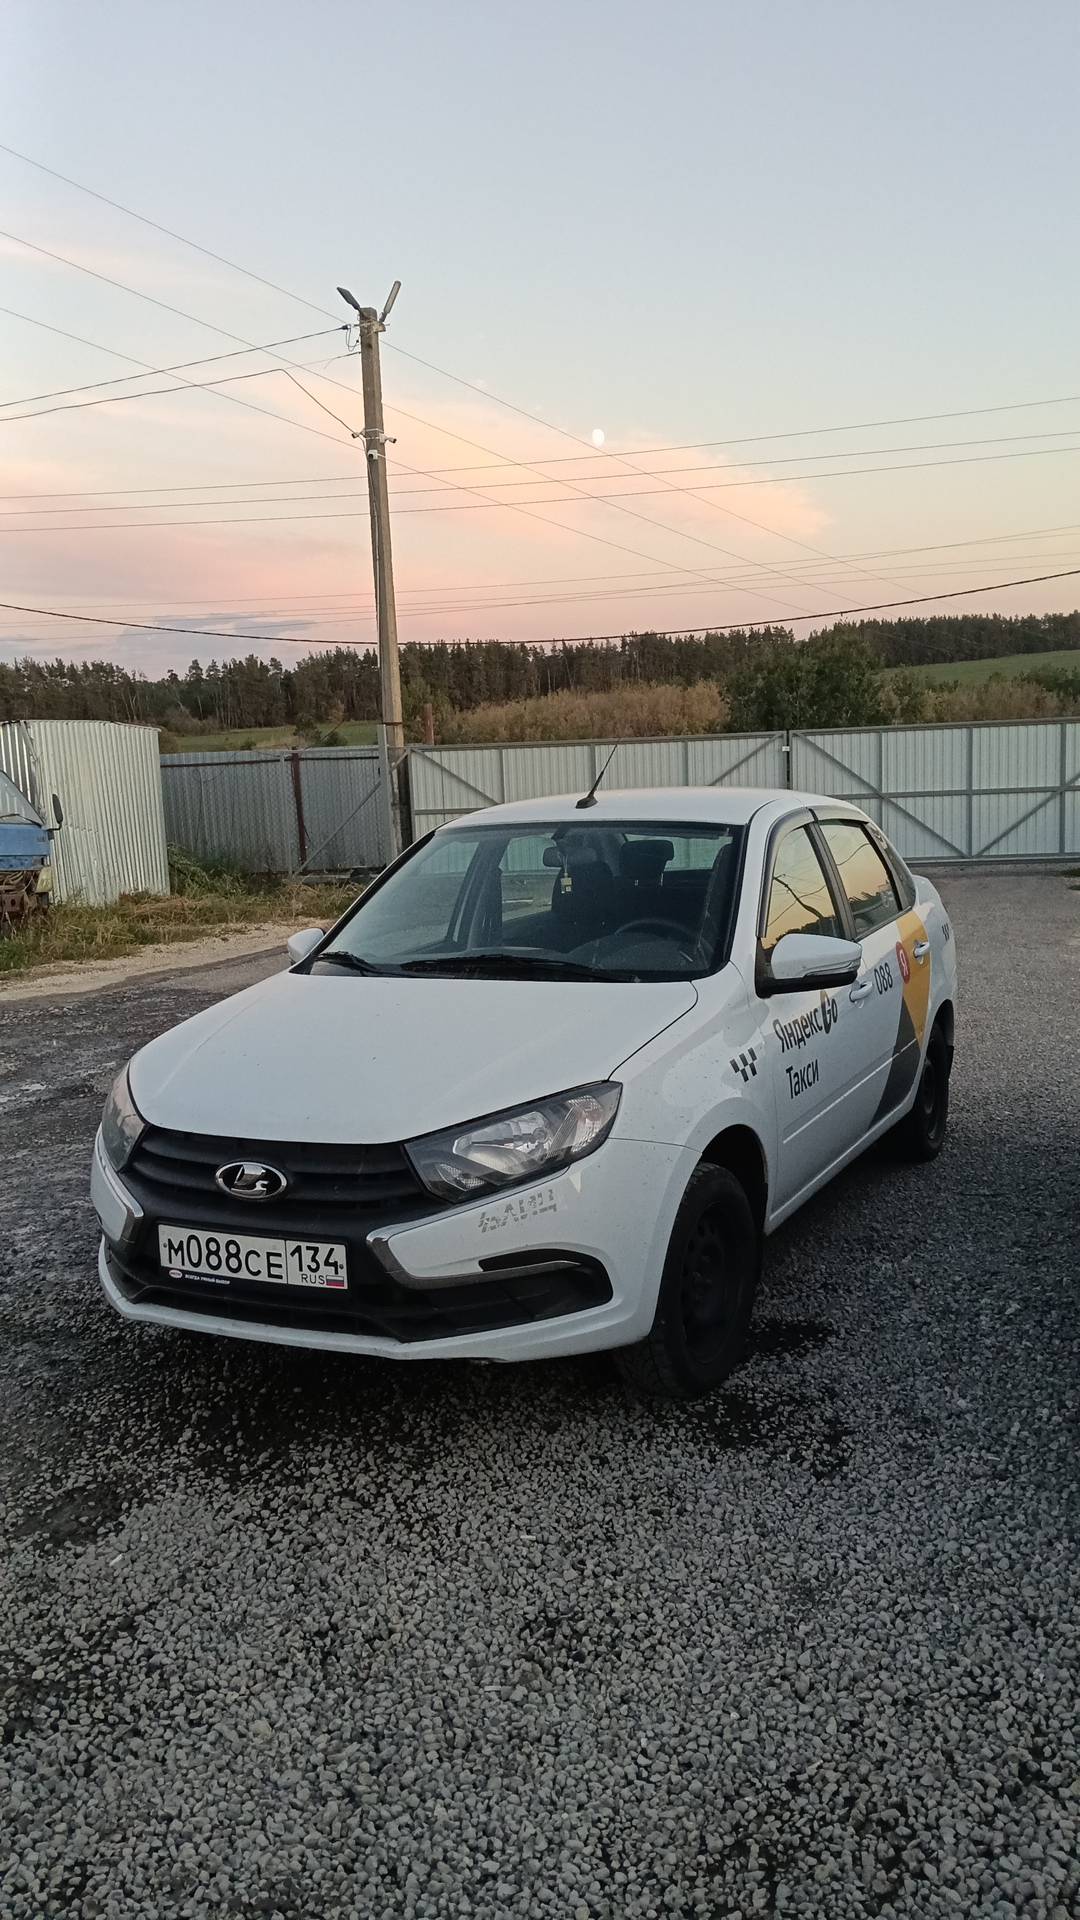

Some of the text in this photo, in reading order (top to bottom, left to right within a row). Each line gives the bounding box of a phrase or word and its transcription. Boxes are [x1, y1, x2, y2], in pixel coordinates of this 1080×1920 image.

[874, 962, 893, 995] 088
[772, 990, 838, 1053] Яндекс Go
[786, 1059, 819, 1099] Такси
[290, 1244, 339, 1275] 134
[302, 1273, 325, 1285] RUS
